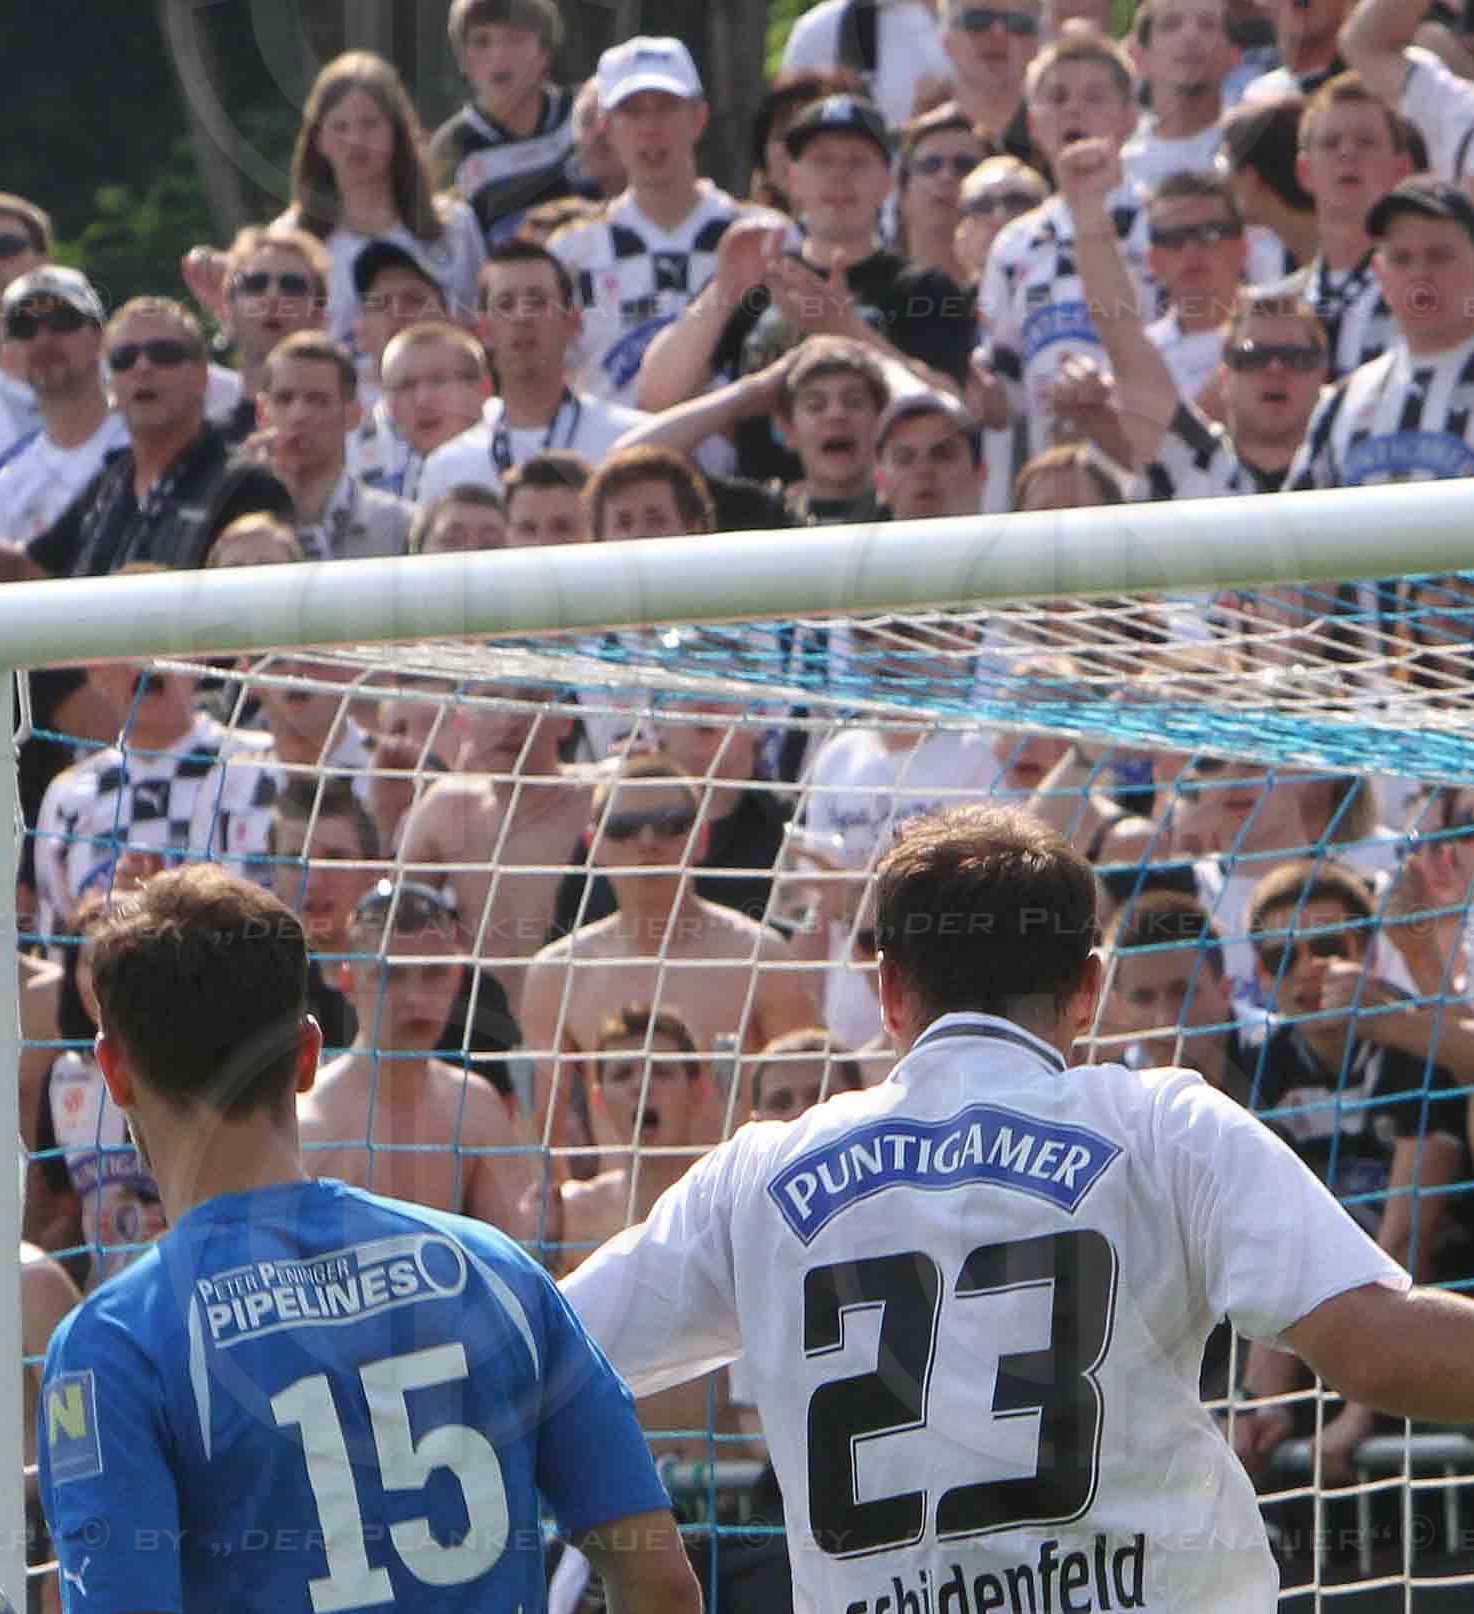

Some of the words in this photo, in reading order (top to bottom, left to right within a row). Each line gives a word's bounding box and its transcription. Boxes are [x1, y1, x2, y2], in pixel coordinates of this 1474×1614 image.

[783, 1123, 1092, 1220] PUNTIGAMER
[197, 1275, 258, 1302] PETER
[207, 1259, 419, 1340] PIPELINES
[803, 1227, 1121, 1561] 23
